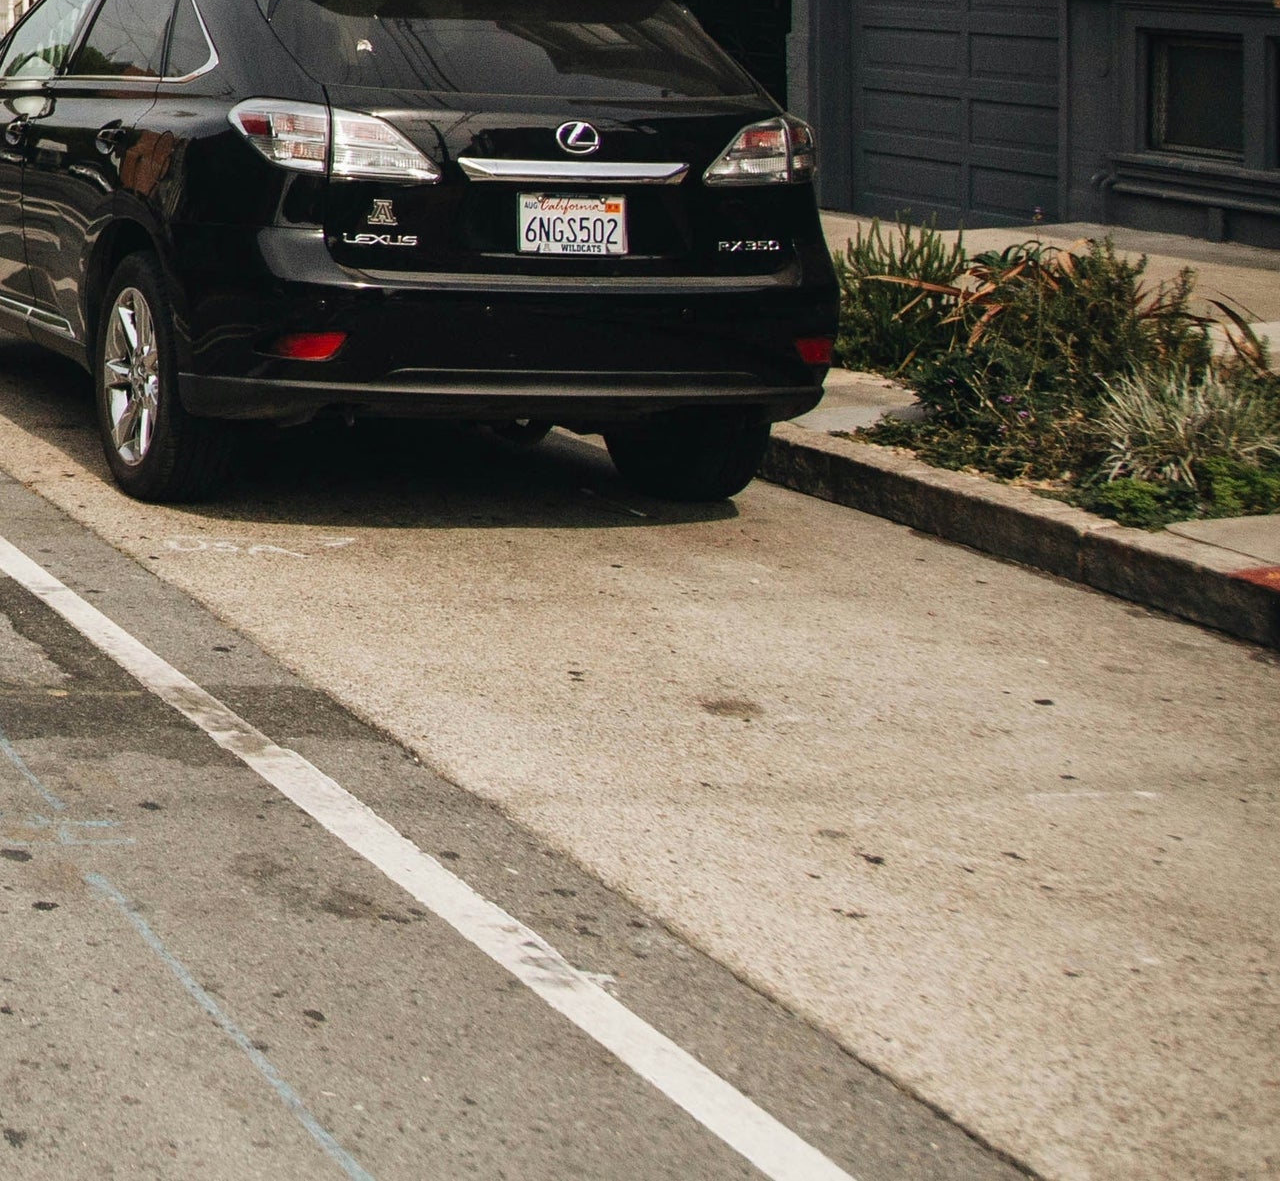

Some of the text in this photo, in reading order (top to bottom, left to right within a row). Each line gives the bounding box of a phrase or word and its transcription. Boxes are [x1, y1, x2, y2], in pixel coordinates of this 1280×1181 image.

[524, 201, 538, 209] AUG
[539, 197, 601, 215] California
[525, 216, 618, 244] 6NGS502
[342, 232, 418, 246] LEXUS
[561, 244, 602, 252] WILDCATS
